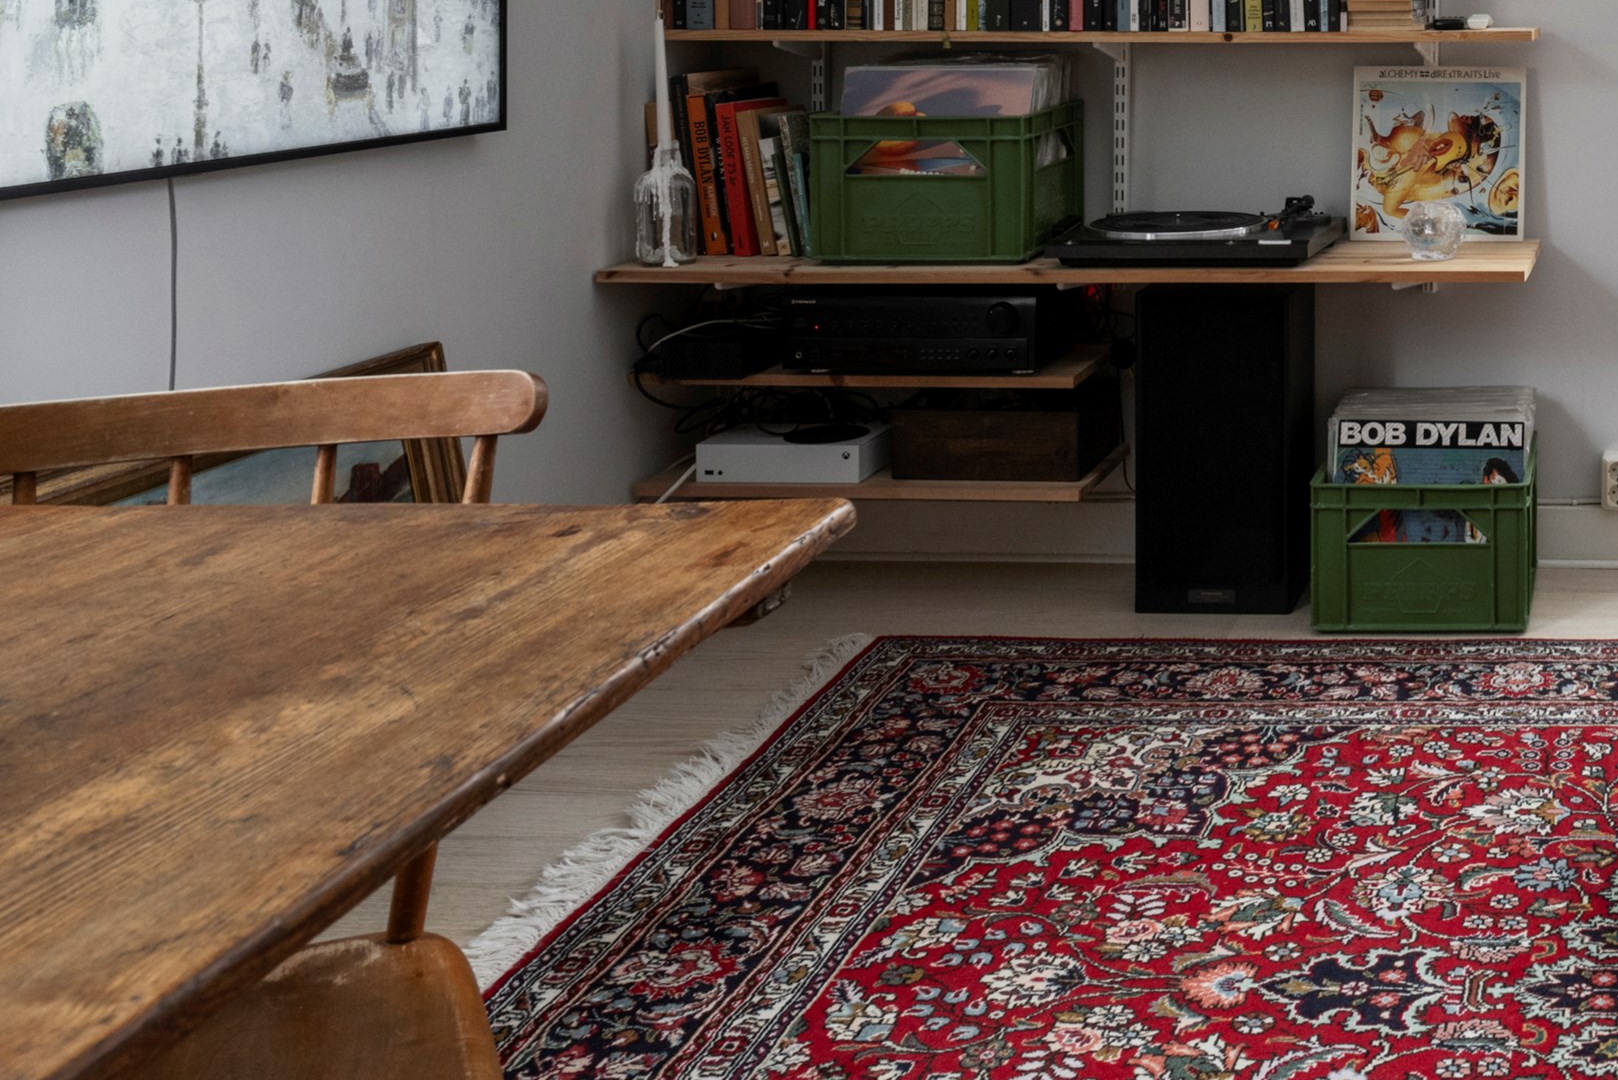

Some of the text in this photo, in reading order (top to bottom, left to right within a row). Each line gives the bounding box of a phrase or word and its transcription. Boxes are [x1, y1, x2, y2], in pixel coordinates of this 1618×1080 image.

[693, 120, 713, 184] BOB DYLAN
[720, 115, 731, 133] JAN
[726, 162, 737, 176] 75
[1339, 421, 1523, 447] BOB DYLAN
